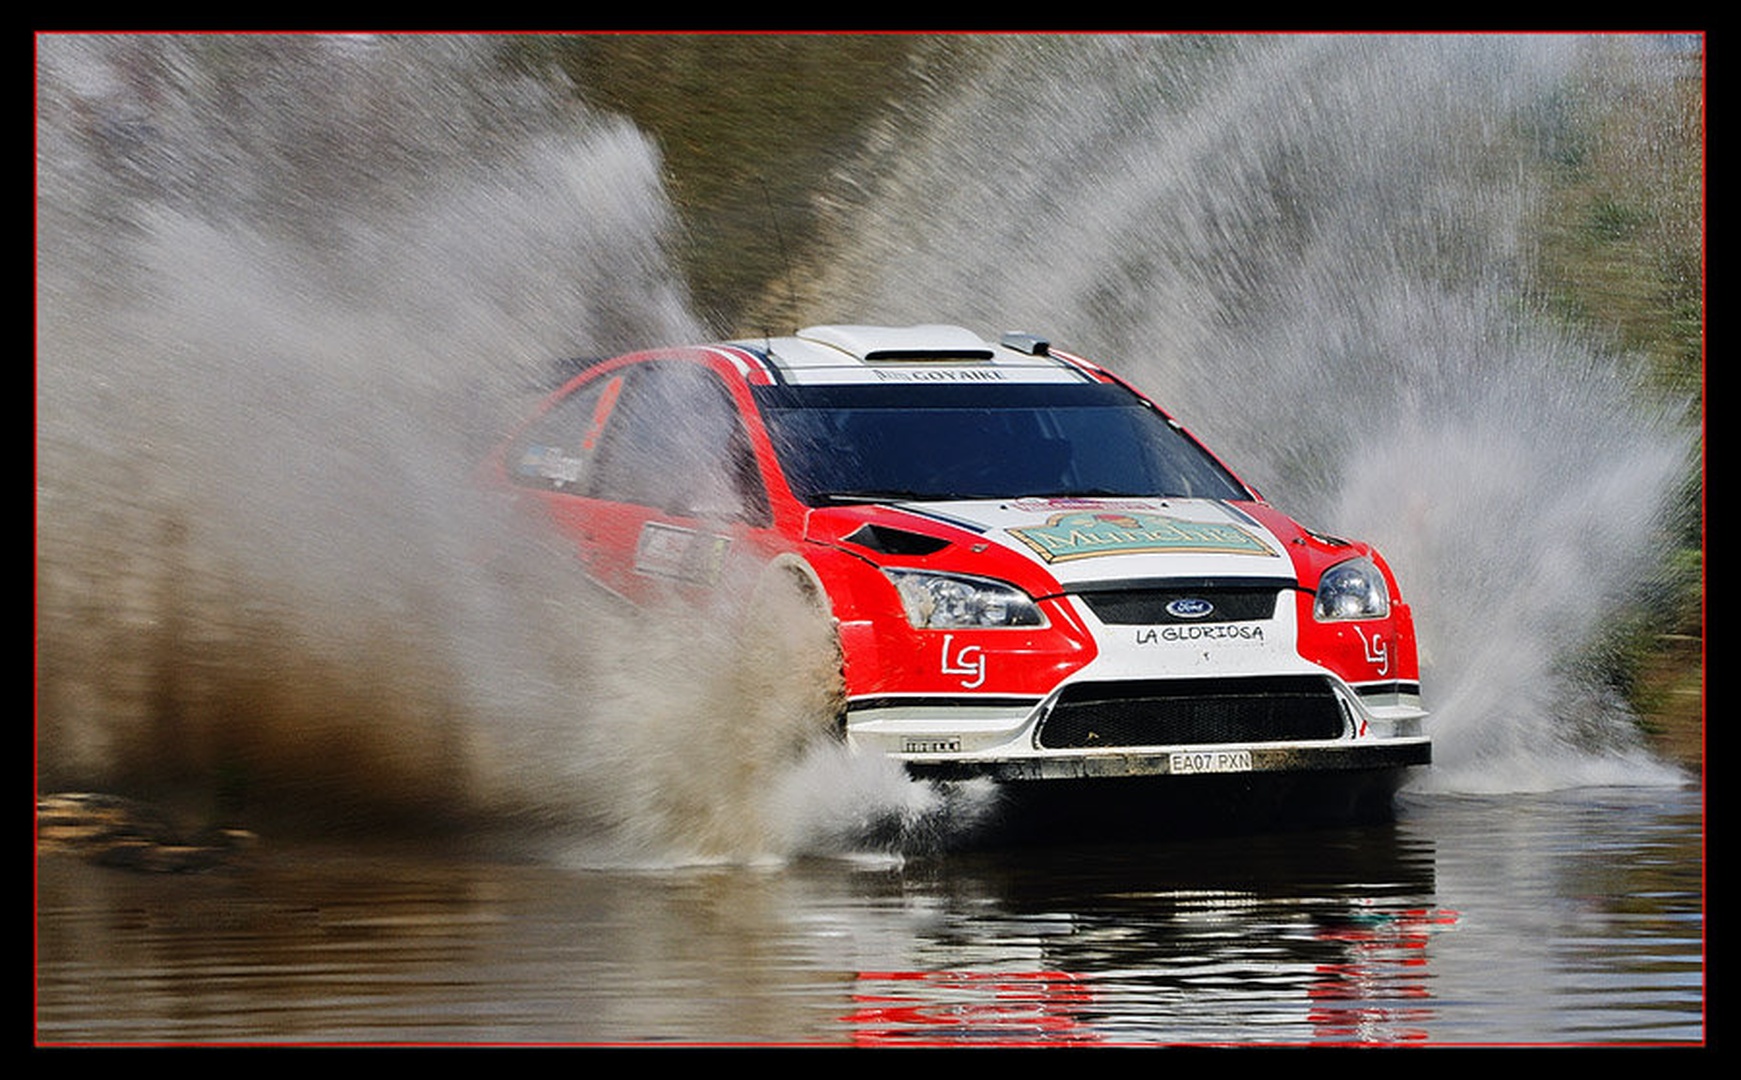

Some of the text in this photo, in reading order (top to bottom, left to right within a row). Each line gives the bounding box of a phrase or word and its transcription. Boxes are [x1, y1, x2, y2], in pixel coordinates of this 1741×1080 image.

[1177, 600, 1204, 613] Ford
[1137, 625, 1264, 644] LA GLORIOSA
[1172, 753, 1250, 771] EA07 PXN
